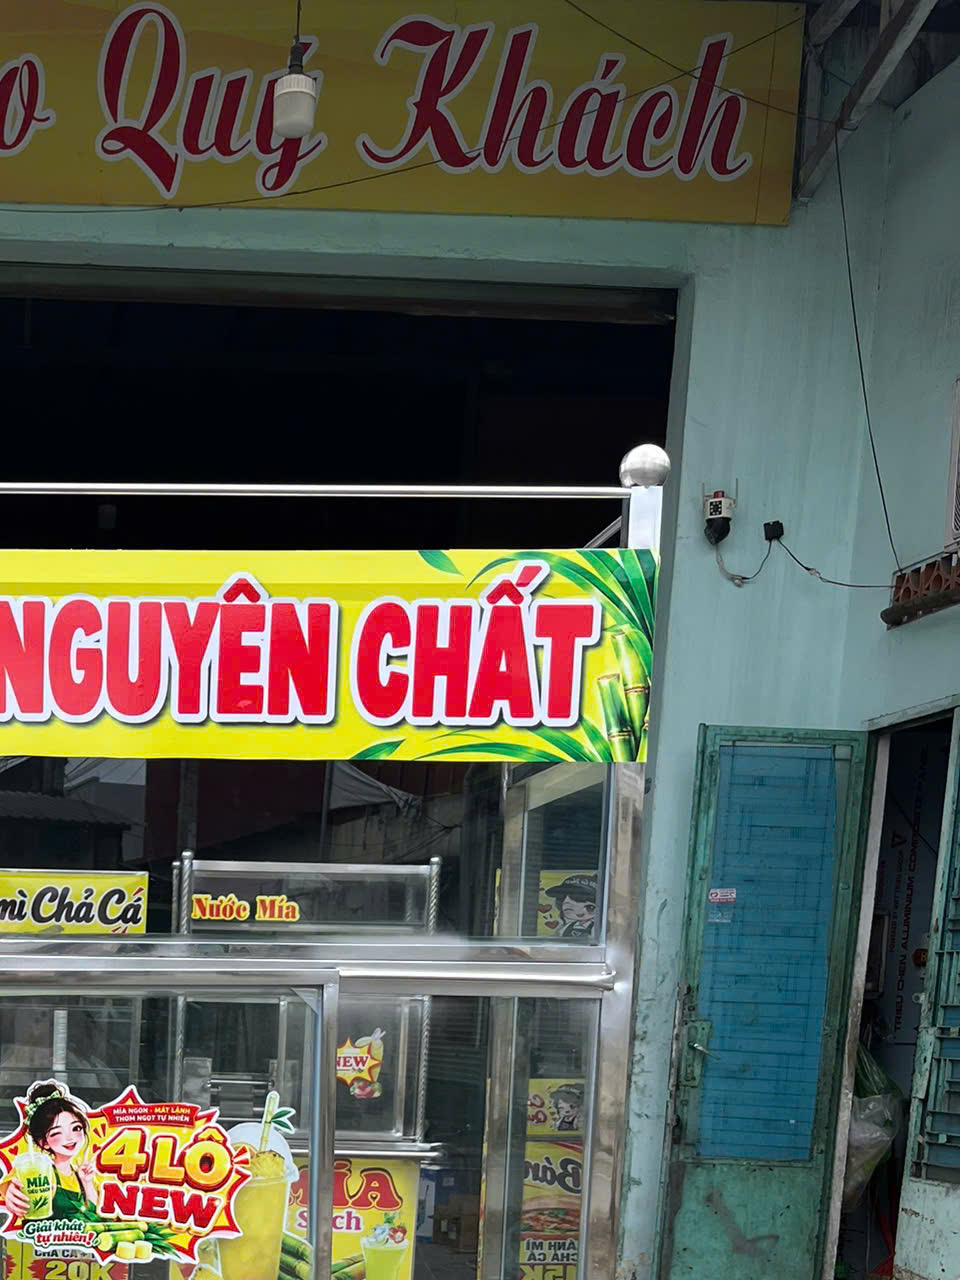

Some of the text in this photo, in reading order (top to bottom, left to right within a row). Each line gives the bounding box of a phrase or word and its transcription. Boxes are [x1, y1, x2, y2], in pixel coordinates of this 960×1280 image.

[359, 19, 751, 174] Khách
[353, 563, 598, 721] CHẤT
[30, 885, 94, 926] Chả
[96, 887, 143, 925] Cá
[191, 894, 300, 922] Nước Mía
[26, 1174, 50, 1189] MÍA
[101, 1183, 220, 1230] NEW
[297, 1209, 362, 1231] Sch
[25, 1219, 83, 1235] Giải khát
[36, 1232, 95, 1246] tự nhiên!
